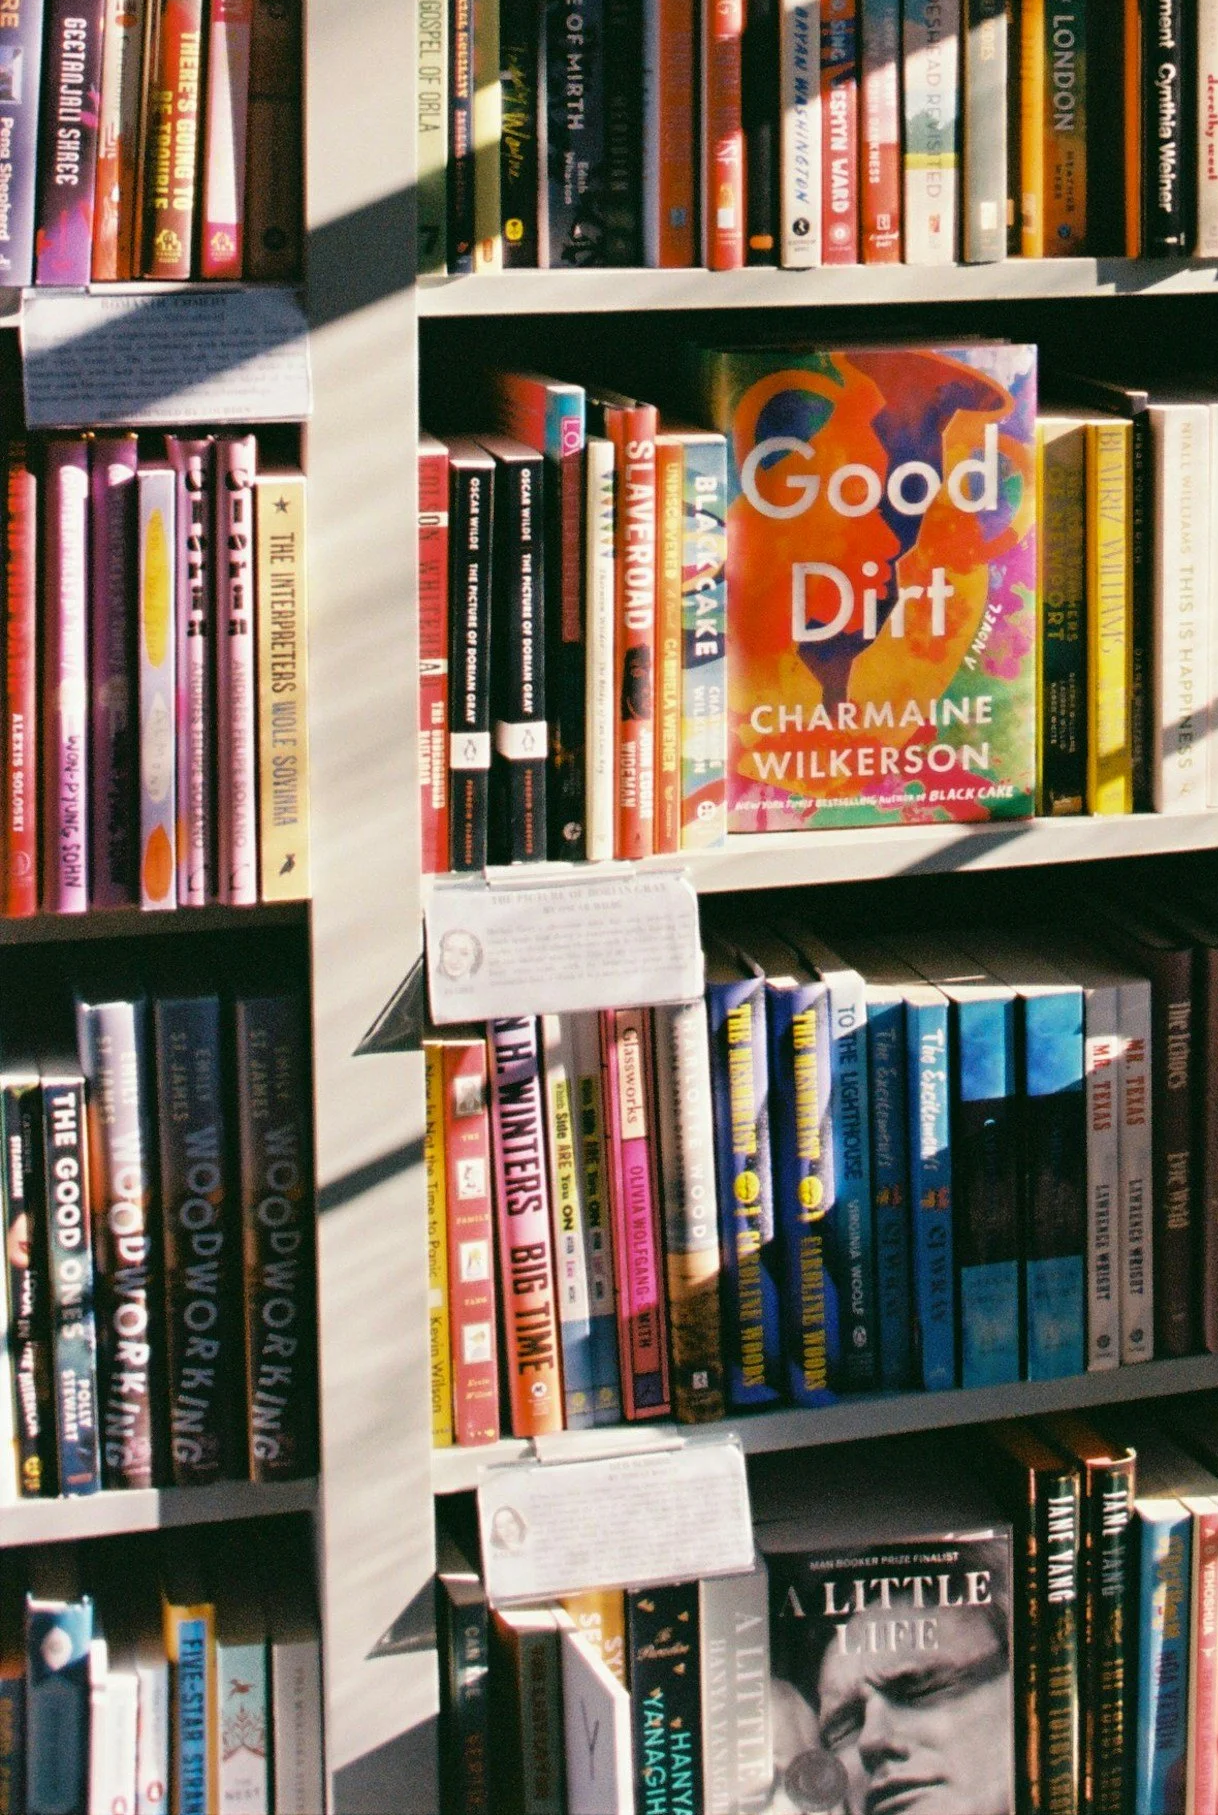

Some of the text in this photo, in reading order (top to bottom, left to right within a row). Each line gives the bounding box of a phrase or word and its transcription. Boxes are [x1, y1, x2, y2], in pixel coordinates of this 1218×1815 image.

[419, 0, 441, 58] GOSPEL
[565, 13, 584, 46] OF
[793, 6, 810, 71] BRYAN
[59, 18, 86, 121] GEETANJALI
[177, 31, 200, 113] THERE'S
[420, 66, 441, 86] OF
[565, 53, 584, 131] MIRTH
[1052, 14, 1074, 132] LONDON
[419, 92, 440, 133] ORLA
[1153, 62, 1176, 137] Cynthia
[56, 129, 81, 185] SHREE
[154, 91, 172, 210] BE TROUBLE
[175, 119, 198, 180] GOING
[793, 77, 810, 204] WASHINGTON
[925, 93, 943, 198] REVISITED
[174, 187, 192, 211] TO
[1157, 144, 1176, 212] Weiner
[521, 469, 531, 505] OSCAR
[741, 424, 999, 519] Good
[521, 509, 531, 541] WILDE
[623, 441, 653, 630] SLAVEROAD
[522, 554, 532, 576] THE
[694, 477, 719, 656] BLACK CAKE
[522, 579, 532, 617] PICTURE
[791, 561, 954, 642] Dirt
[522, 621, 532, 635] OF
[964, 602, 1002, 670] A NOVEL
[270, 533, 298, 827] THE INTERPRETERS WOLE SOYINKA
[522, 637, 532, 678] DORIAN
[522, 682, 534, 713] GRAY
[751, 696, 993, 734] CHARMAINE
[753, 743, 990, 781] WILKERSON
[735, 802, 753, 811] NEW
[755, 800, 783, 810] YORK
[815, 794, 877, 809] BESTSELLING
[929, 788, 975, 802] BLACK
[978, 785, 1013, 799] CAKE
[838, 1006, 855, 1027] TO
[497, 1044, 531, 1073] H.
[840, 1032, 858, 1065] THE
[498, 1079, 544, 1216] WINTERS
[842, 1071, 863, 1179] LIGHTHOUSE
[53, 1093, 83, 1339] THE GOOD ONES
[253, 1124, 301, 1459] WOODWORKING
[510, 1243, 550, 1294] BIG
[850, 1266, 865, 1314] WOOLF
[516, 1307, 554, 1374] TIME
[810, 1560, 834, 1570] MAN
[836, 1557, 877, 1567] BOOKER
[913, 1552, 959, 1564] FINALIST
[779, 1570, 991, 1618] A LITTLE
[835, 1618, 939, 1655] LIFE
[182, 1639, 202, 1741] FIVE-STAR
